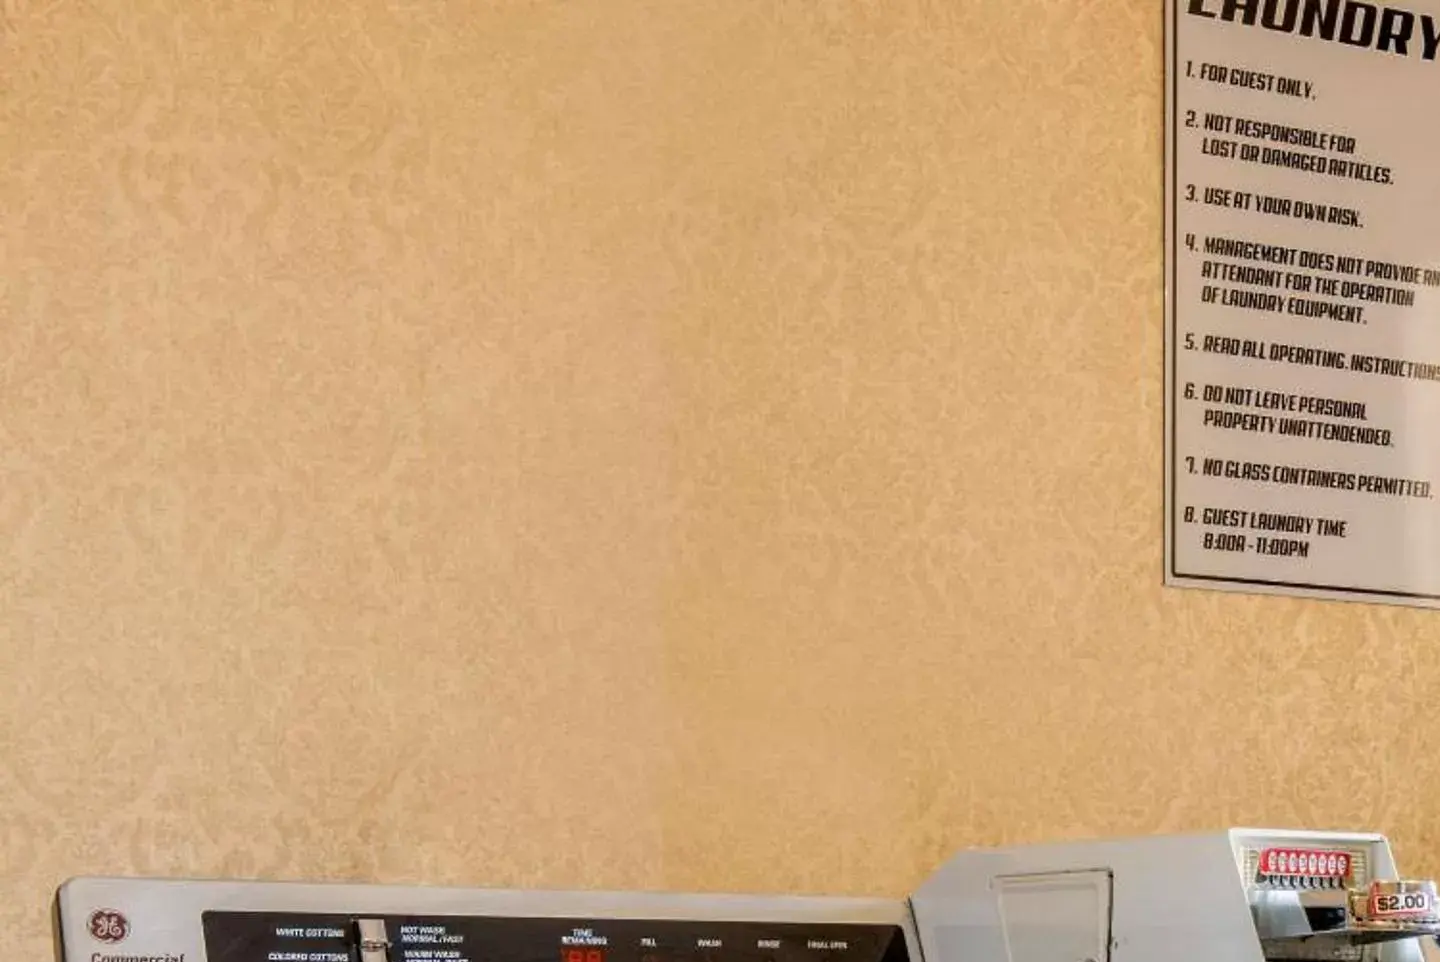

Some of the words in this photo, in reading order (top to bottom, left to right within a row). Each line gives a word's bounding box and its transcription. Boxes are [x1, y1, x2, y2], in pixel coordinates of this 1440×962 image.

[1185, 61, 1196, 78] 1.
[1200, 63, 1228, 84] FOR
[1230, 70, 1274, 92] GUEST
[1277, 77, 1317, 101] ONLY.
[1185, 110, 1200, 129] 2.
[1204, 113, 1233, 135] NOT
[1235, 118, 1328, 150] RESPONSIBLE
[1329, 134, 1356, 154] FOR
[1202, 138, 1237, 158] LOST
[1240, 144, 1260, 162] OR
[1262, 146, 1326, 174] DAMAGED
[1329, 159, 1395, 186] ARTICLES.
[1185, 184, 1199, 203] 3.
[1204, 187, 1231, 208] USE
[1233, 192, 1251, 210] AT
[1256, 194, 1291, 217] YOUR
[1293, 201, 1326, 222] OWN
[1328, 206, 1364, 228] RISK.
[1185, 234, 1199, 252] 4.
[1203, 236, 1297, 266] MANAGEMENT
[1299, 249, 1334, 272] DOES
[1337, 254, 1364, 276] NOT
[1365, 259, 1421, 285] PROVIDE
[1201, 261, 1282, 289] ATTENDANT
[1285, 273, 1312, 293] FOR
[1315, 277, 1340, 296] THE
[1341, 280, 1415, 306] OPERATION
[1201, 286, 1220, 304] OF
[1222, 288, 1284, 314] LAUNDRY
[1287, 297, 1368, 325] EQUIPMENT.
[1184, 333, 1198, 351] 5.
[1203, 335, 1240, 357] READ
[1242, 340, 1265, 360] ALL
[1184, 383, 1198, 400] 6.
[1203, 385, 1223, 403] DO
[1225, 387, 1253, 407] NOT
[1255, 390, 1297, 412] LEAVE
[1299, 396, 1367, 421] PERSONAL
[1203, 410, 1277, 435] PROPERTY
[1185, 457, 1198, 475] 7.
[1203, 458, 1222, 477] NO
[1225, 460, 1270, 481] GLASS
[1273, 465, 1355, 491] CONTAINERS
[1358, 475, 1434, 500] PERMITTED.
[1184, 506, 1198, 524] 8.
[1203, 508, 1248, 528] GUEST
[1250, 512, 1313, 534] LAUNDRY
[1316, 519, 1347, 538] TIME
